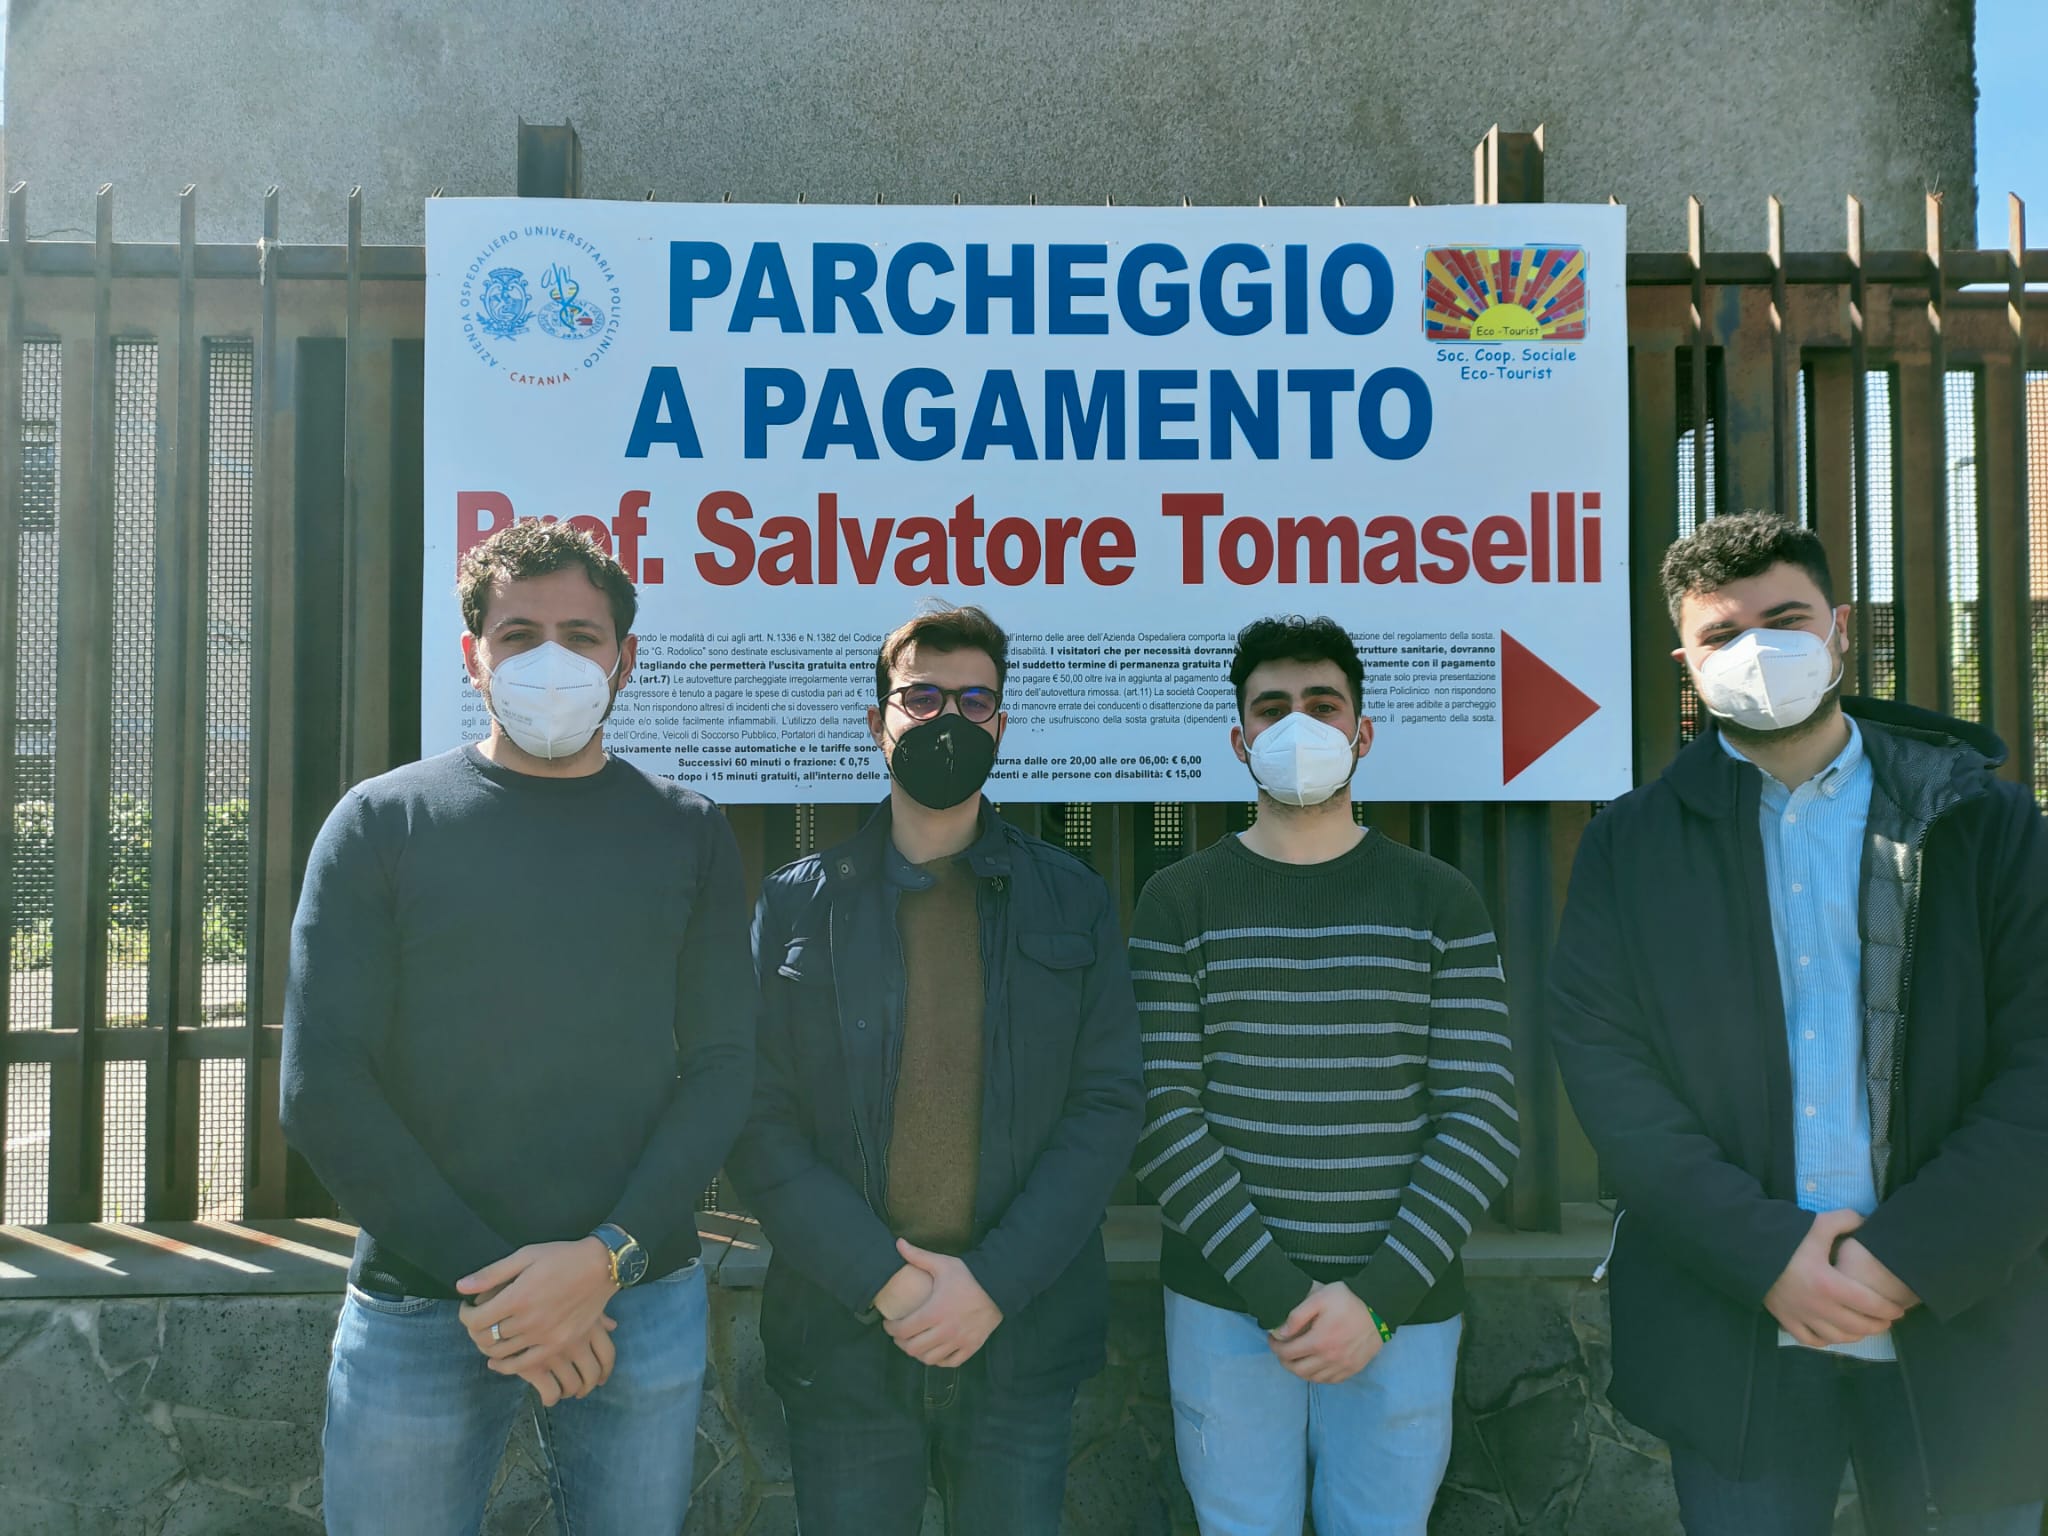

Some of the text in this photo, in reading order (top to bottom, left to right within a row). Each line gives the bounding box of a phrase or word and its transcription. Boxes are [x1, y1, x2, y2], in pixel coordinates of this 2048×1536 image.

[525, 226, 615, 282] UNIVERSITARIA
[460, 231, 518, 307] OSPEDALIERO
[669, 241, 1394, 335] PARCHEGGIO
[583, 287, 621, 368] POLICLINICO
[1476, 326, 1495, 336] Eco
[462, 313, 498, 367] AZIENDA
[1437, 348, 1577, 364] Soc. Coop. Sociale
[510, 372, 570, 386] CATANIA
[1461, 366, 1553, 380] Eco-Tourist
[625, 366, 1433, 462] A PAGAMENTO
[456, 490, 1601, 587] Pf. Salvatore Tomaselli
[640, 661, 686, 672] tagliando
[690, 661, 707, 670] che
[710, 661, 765, 672] permetterà
[808, 661, 846, 672] gratuita
[850, 661, 876, 670] entro
[1006, 660, 1019, 669] del
[1022, 660, 1065, 669] suddetto
[1068, 660, 1106, 669] termine
[1120, 662, 1179, 671] permanenza
[1182, 660, 1220, 671] gratuita
[1412, 660, 1430, 668] con
[1441, 658, 1496, 670] pagamento
[675, 744, 699, 753] nelle
[734, 744, 796, 753] automatiche
[821, 744, 850, 753] tariffe
[678, 758, 732, 767] Successivi
[750, 758, 782, 767] minuti
[794, 758, 836, 767] frazione:
[848, 758, 870, 769] 0,75
[1024, 756, 1048, 765] dalle
[1070, 756, 1096, 767] 20,00
[1100, 756, 1117, 765] alle
[1181, 756, 1201, 767] 6,00
[678, 772, 702, 782] dopo
[726, 772, 758, 780] minuti
[760, 772, 800, 782] gratuiti,
[856, 772, 880, 780] delle
[1031, 770, 1048, 778] alle
[1052, 772, 1090, 780] persone
[1116, 770, 1162, 778] disabilità:
[1176, 770, 1201, 780] 15,00
